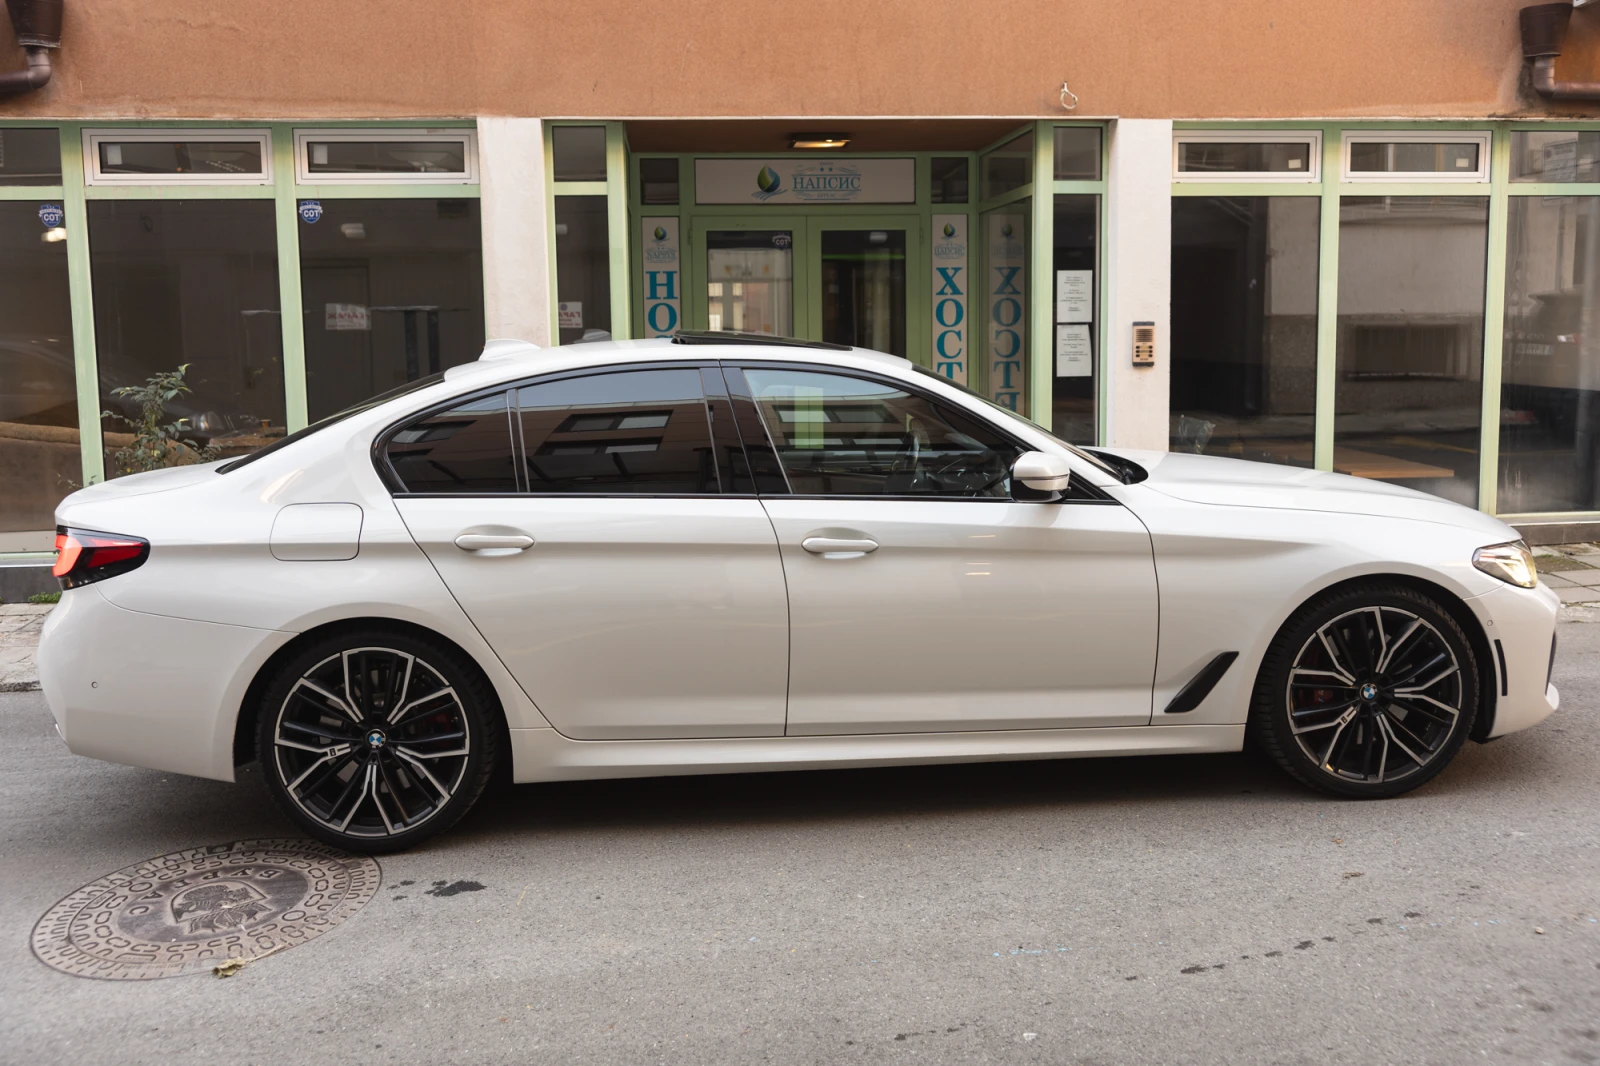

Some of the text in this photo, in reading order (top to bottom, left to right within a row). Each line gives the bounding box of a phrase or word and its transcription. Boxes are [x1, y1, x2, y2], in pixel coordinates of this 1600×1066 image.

[793, 177, 861, 189] НАПСИС
[645, 271, 678, 338] HO
[129, 867, 282, 916] БУРГАС
